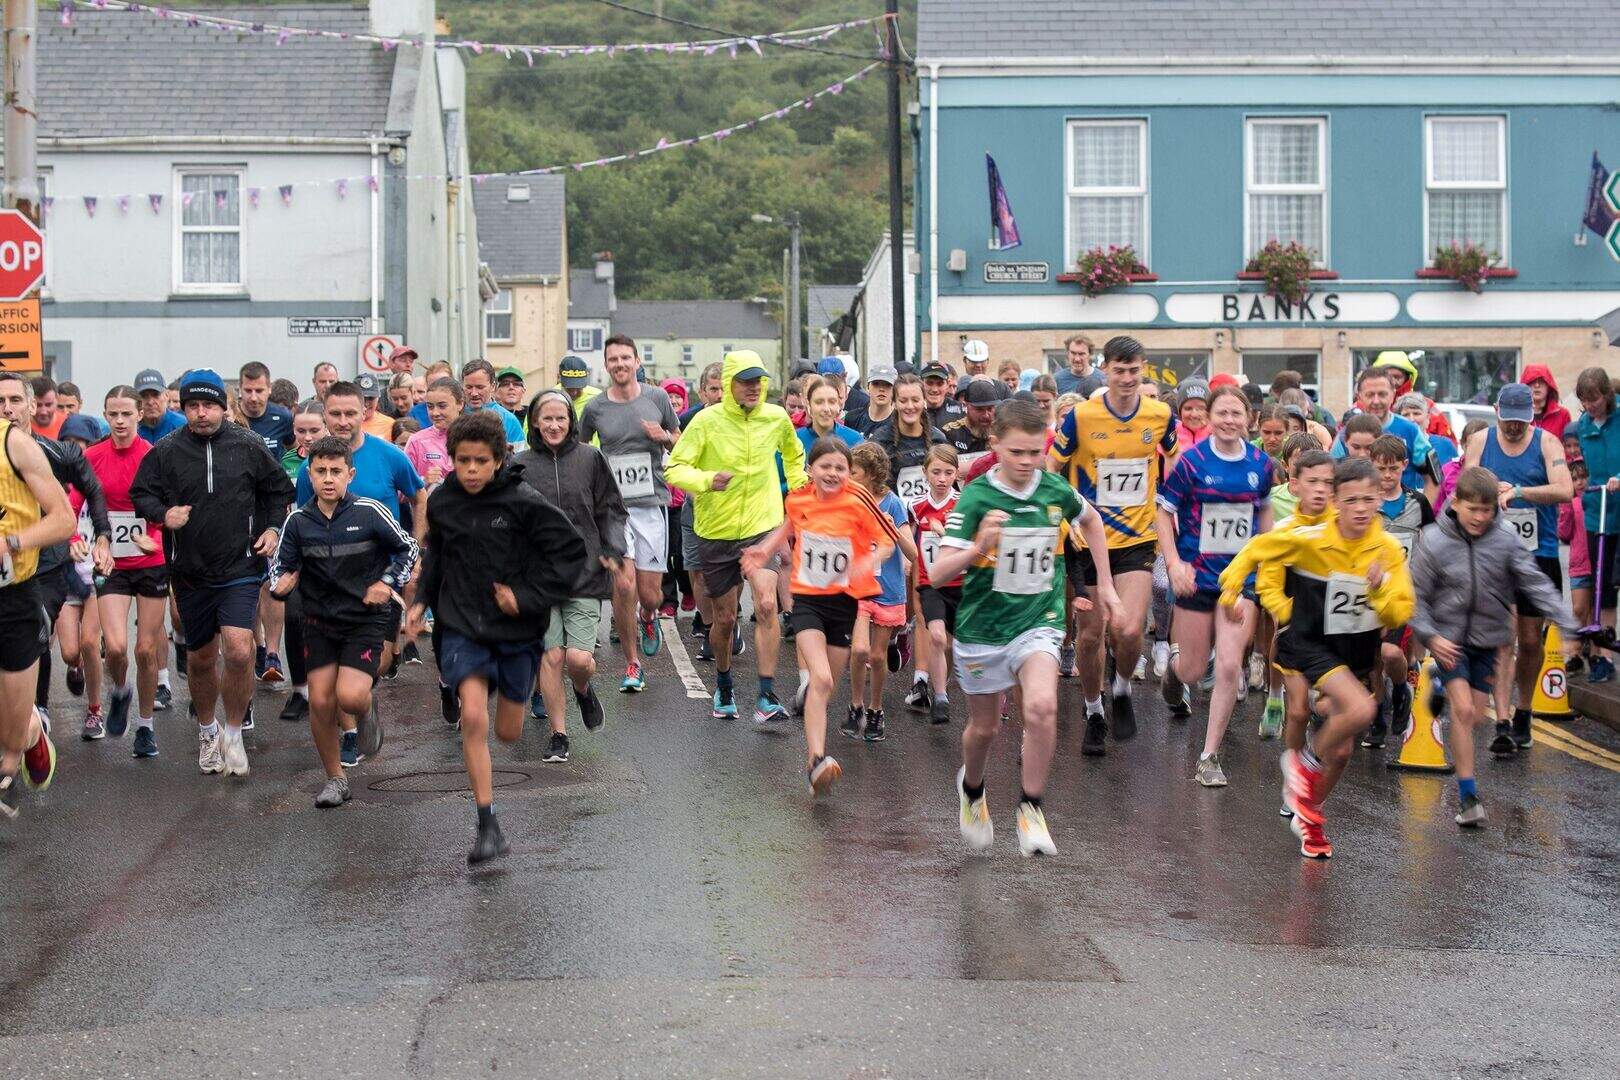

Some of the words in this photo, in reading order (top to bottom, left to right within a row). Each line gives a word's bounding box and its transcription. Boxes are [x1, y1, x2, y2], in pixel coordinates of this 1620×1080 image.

[1223, 293, 1339, 321] BANKS
[561, 369, 587, 378] adidas
[615, 465, 650, 484] 192
[1103, 472, 1144, 492] 177
[1206, 516, 1250, 539] 176
[804, 547, 849, 574] 110
[1003, 546, 1053, 574] 116
